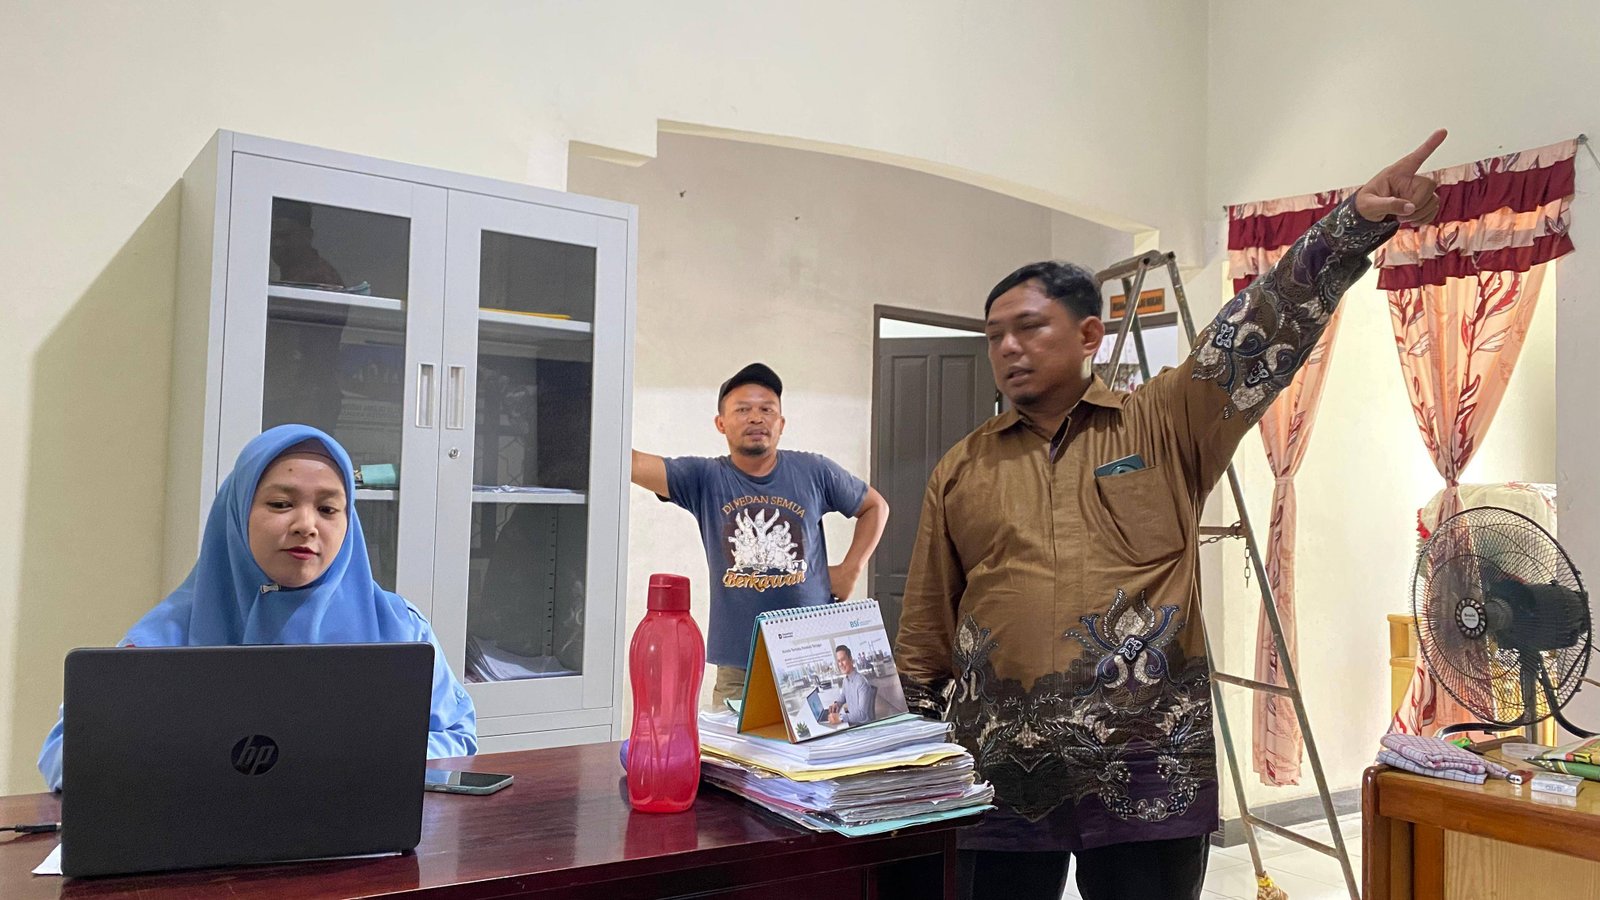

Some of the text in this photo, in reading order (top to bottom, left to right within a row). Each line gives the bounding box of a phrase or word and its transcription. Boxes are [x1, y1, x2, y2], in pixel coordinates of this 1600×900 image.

[722, 502, 735, 515] DI
[770, 496, 806, 518] SEMUA
[236, 734, 275, 775] hp
